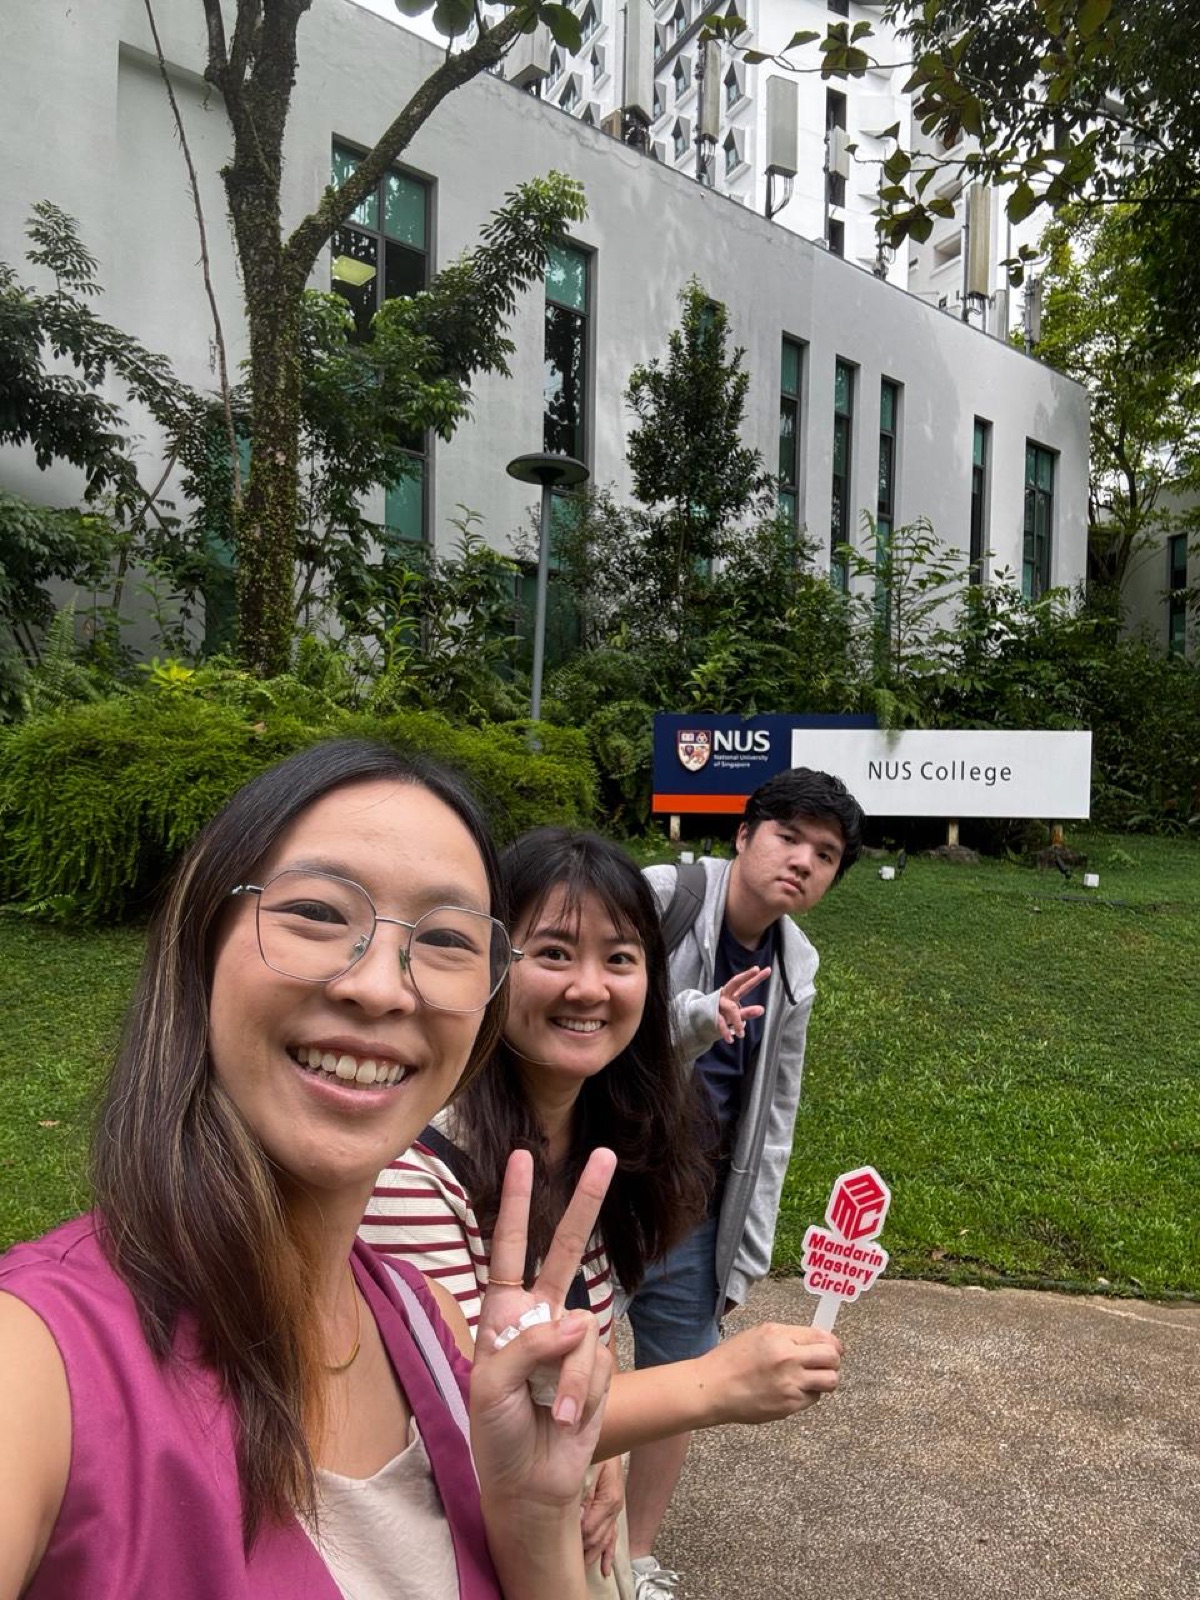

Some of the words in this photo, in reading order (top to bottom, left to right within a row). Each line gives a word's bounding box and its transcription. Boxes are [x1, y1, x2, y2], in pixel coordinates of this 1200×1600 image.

[714, 730, 770, 752] NUS
[721, 761, 750, 769] Singapore
[739, 754, 768, 762] University
[868, 760, 912, 781] NUS
[920, 760, 1012, 786] College
[808, 1233, 883, 1267] Mandarin
[808, 1251, 874, 1285] Mastery
[809, 1271, 856, 1296] Circle
